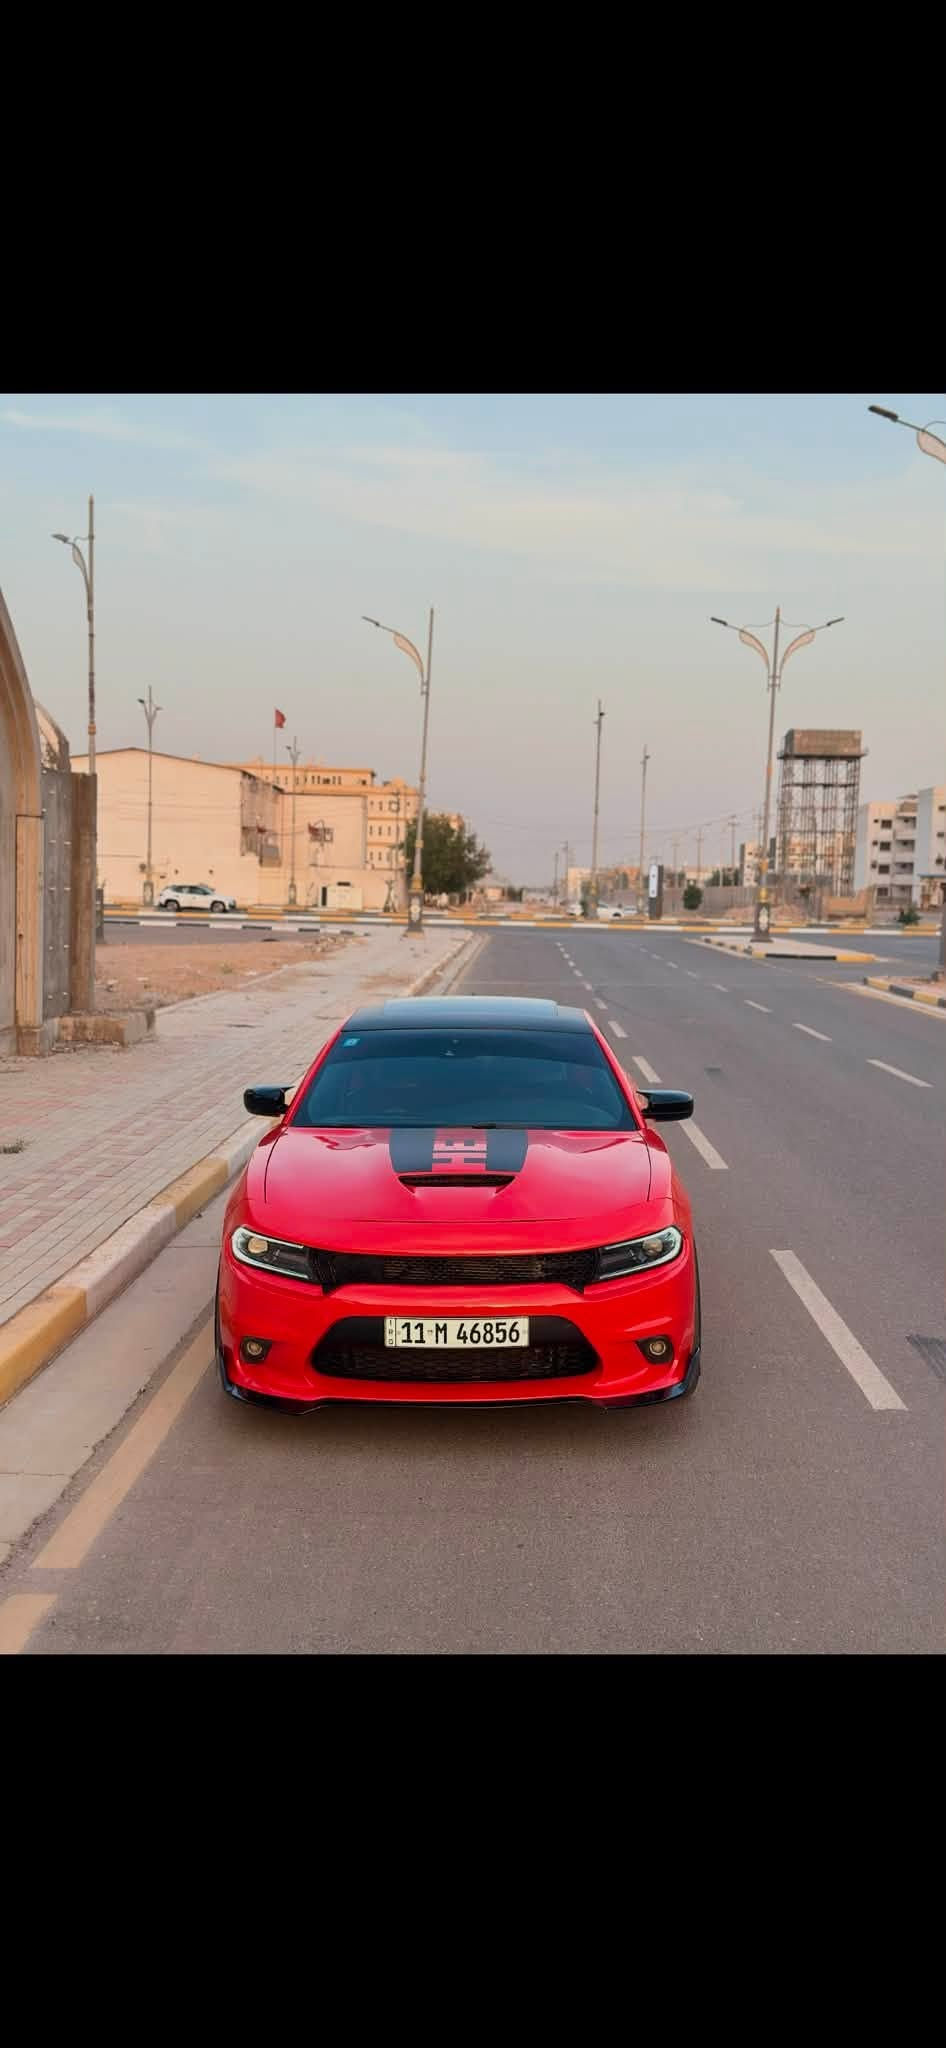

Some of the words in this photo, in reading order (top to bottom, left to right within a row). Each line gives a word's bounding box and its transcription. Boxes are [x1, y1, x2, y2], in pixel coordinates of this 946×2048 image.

[401, 1322, 426, 1344] 11
[435, 1323, 448, 1344] M
[457, 1321, 520, 1344] 46856
